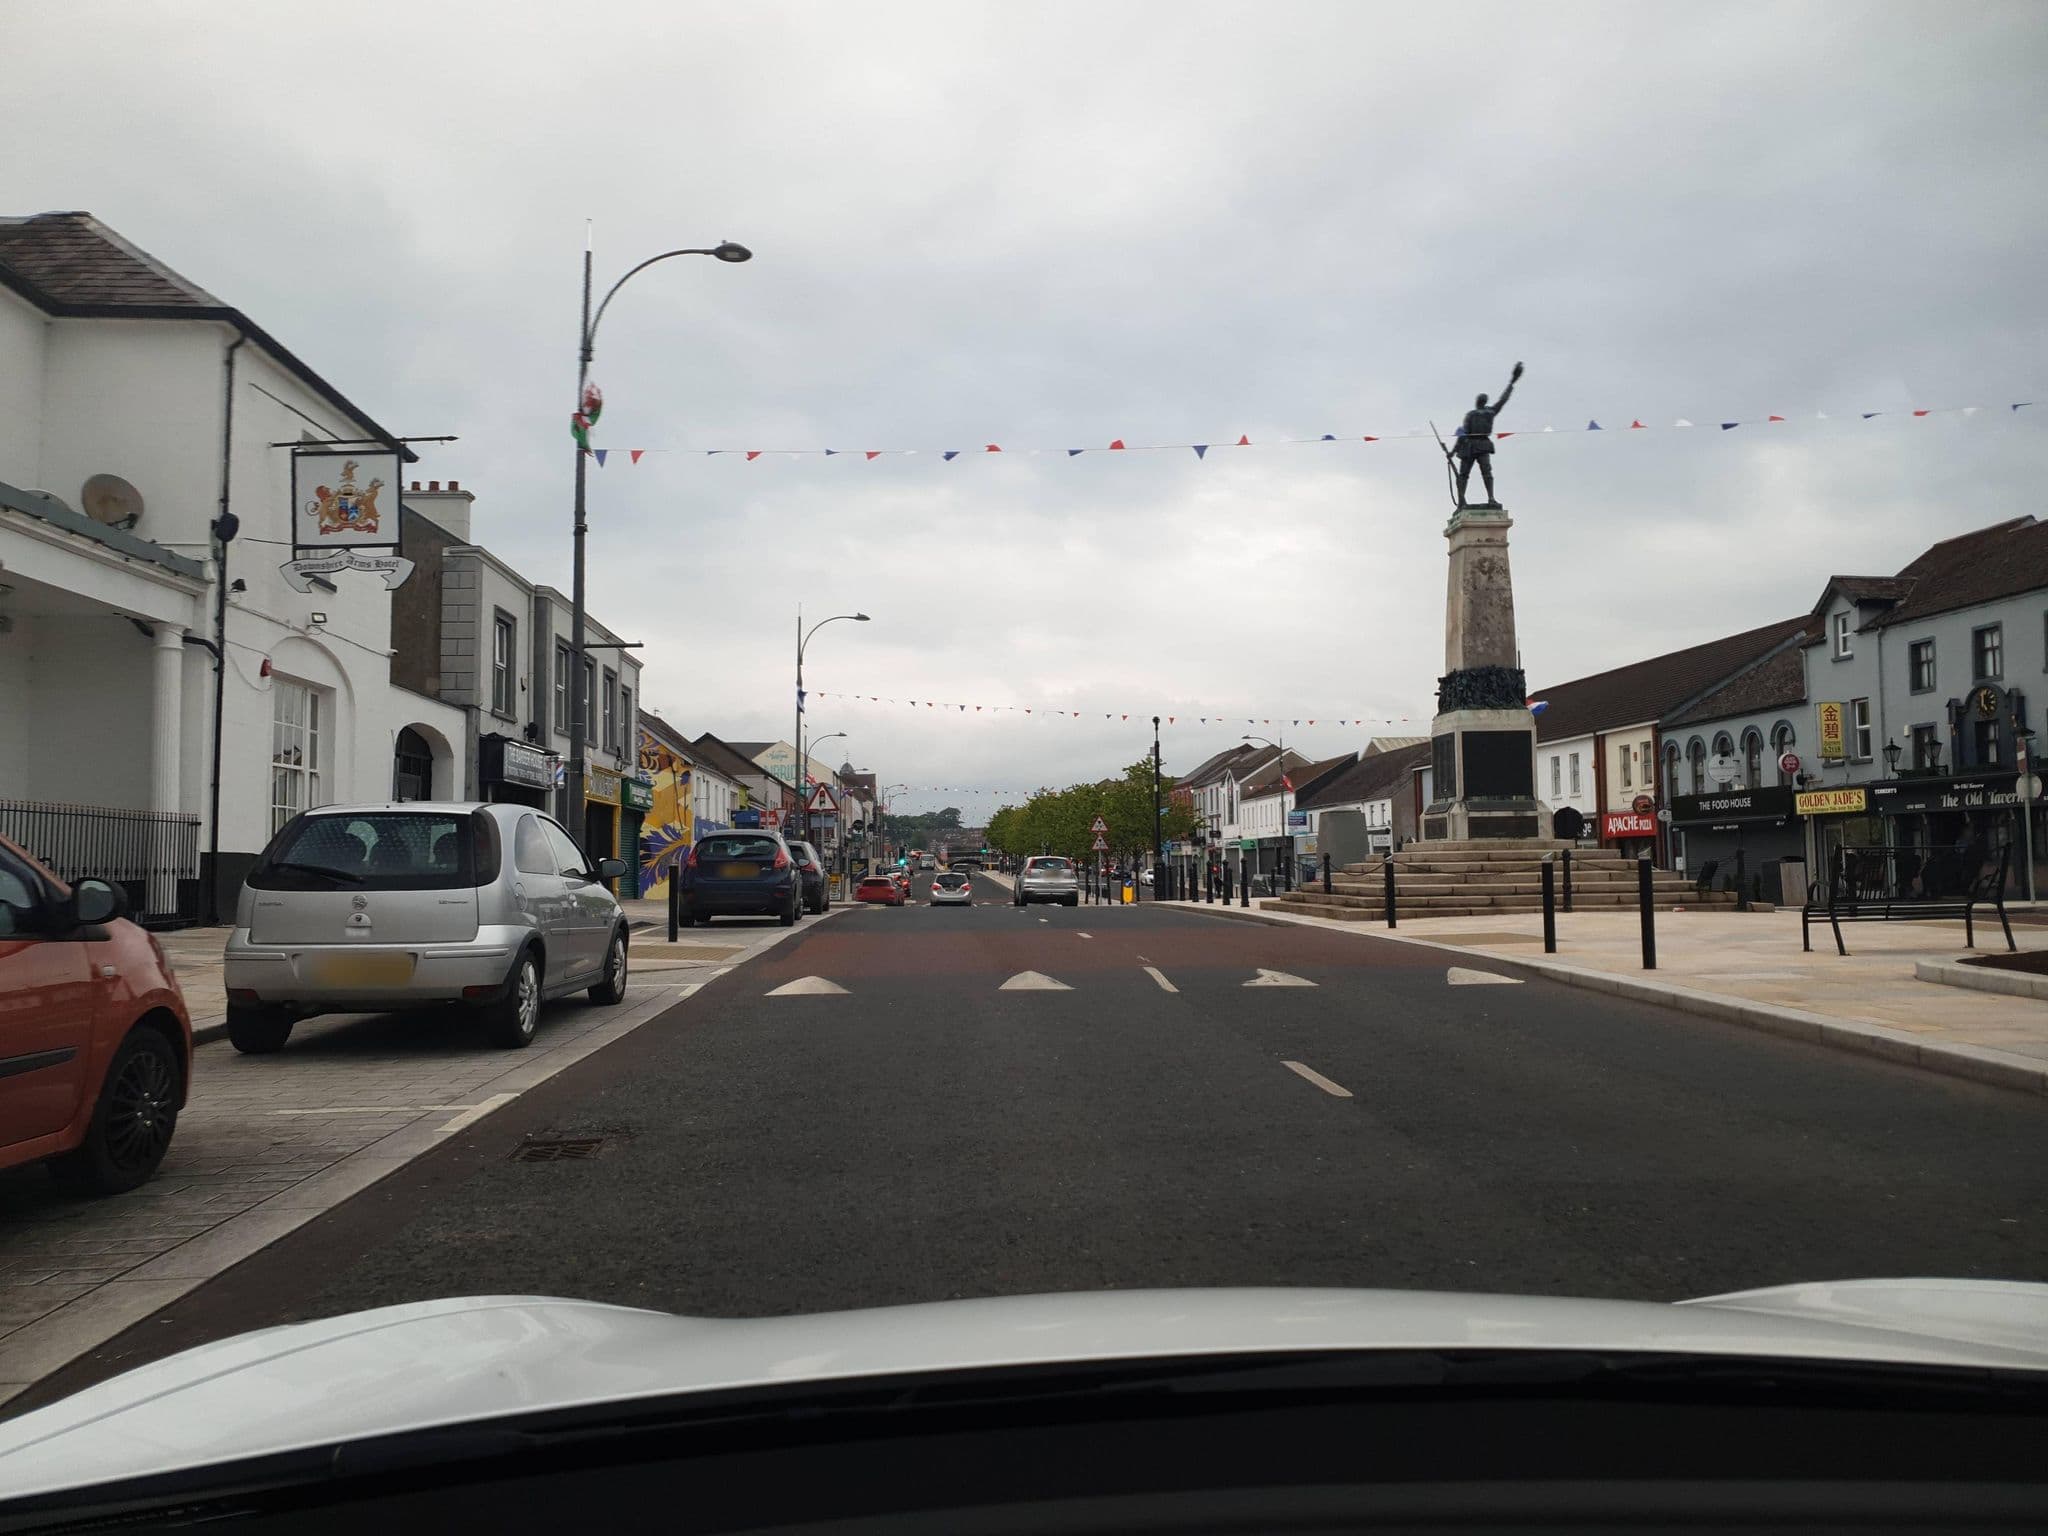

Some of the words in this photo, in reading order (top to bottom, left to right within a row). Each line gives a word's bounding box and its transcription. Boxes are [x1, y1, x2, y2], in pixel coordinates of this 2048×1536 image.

[346, 556, 371, 568] Arms
[374, 559, 399, 569] Hotel
[1824, 705, 1839, 739] 金碧
[1699, 801, 1711, 811] THE
[1711, 799, 1729, 810] FOOD
[1730, 796, 1752, 808] HOUSE
[1799, 793, 1831, 808] GOLDEN
[1833, 790, 1863, 806] JADE'S
[1940, 794, 1959, 808] The
[1965, 791, 1983, 806] Old
[1607, 816, 1639, 835] APACHE
[1639, 819, 1653, 831] PIZZA
